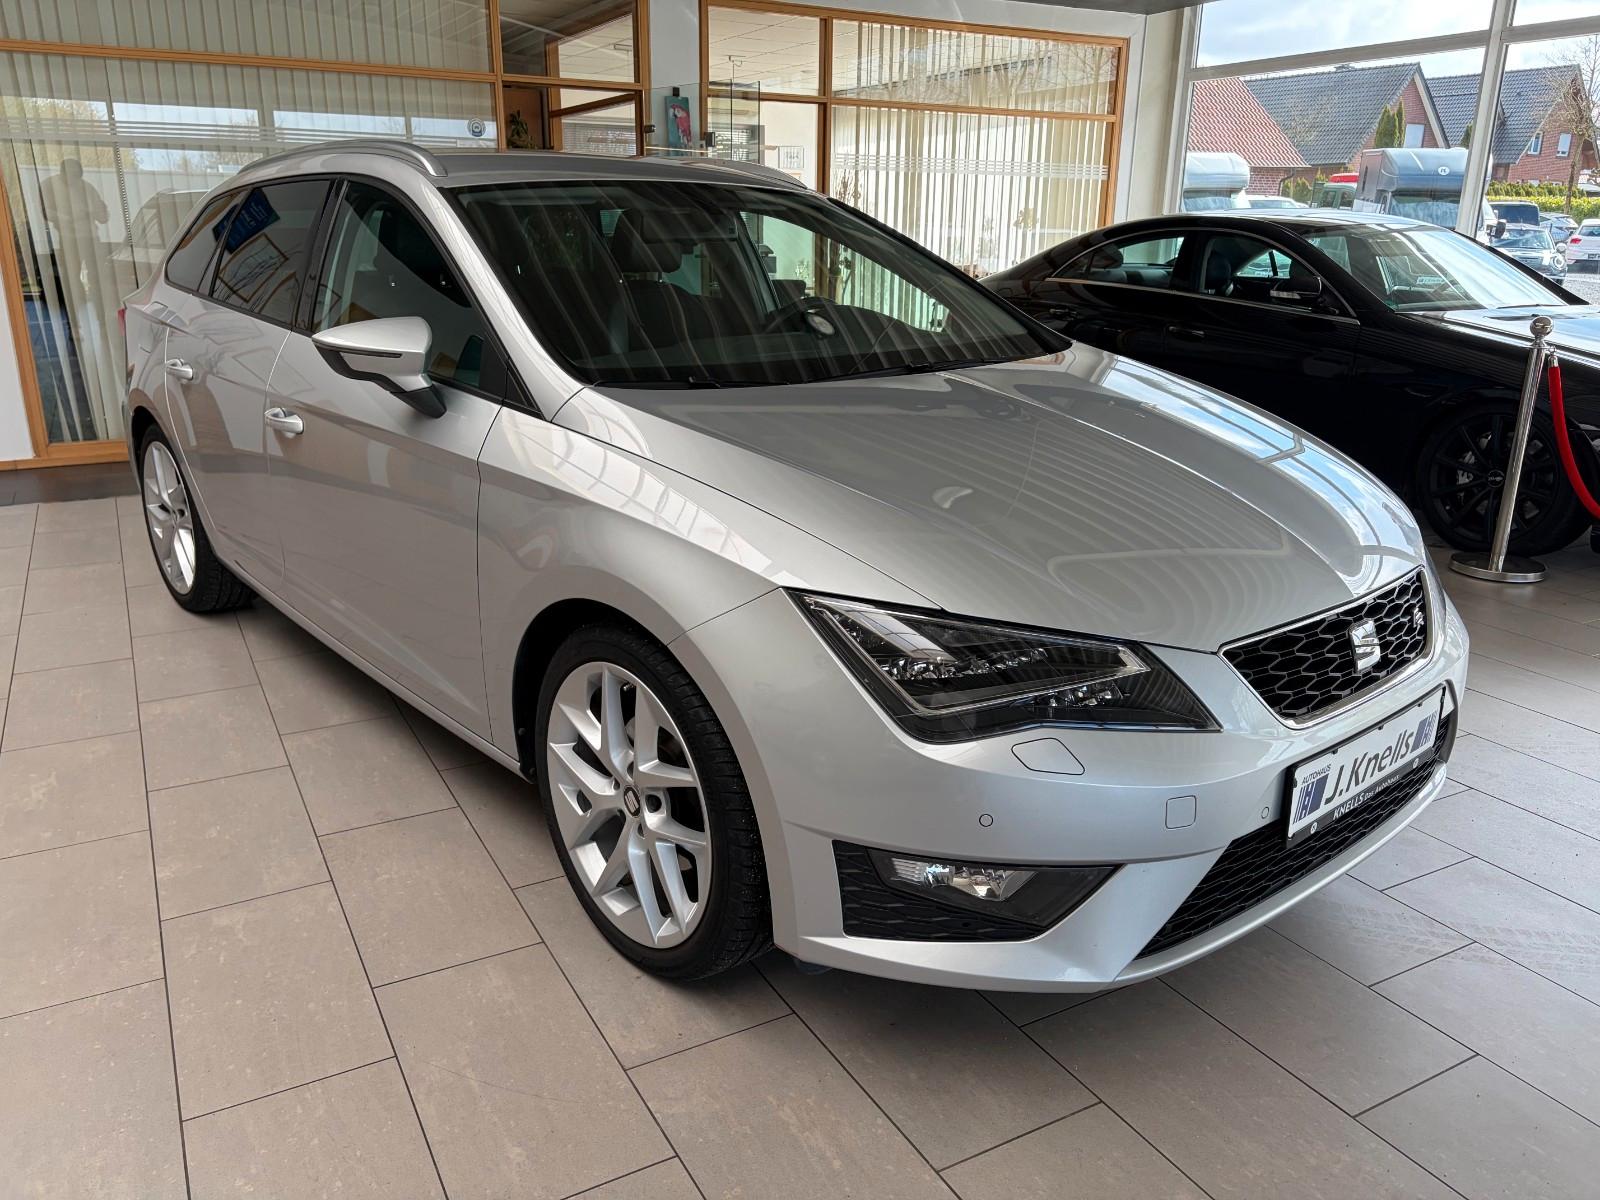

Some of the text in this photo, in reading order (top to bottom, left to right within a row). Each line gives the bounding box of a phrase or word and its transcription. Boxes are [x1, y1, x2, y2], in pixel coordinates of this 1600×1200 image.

[1301, 763, 1331, 785] AUTOHAUS
[1324, 729, 1415, 806] J.Knells
[1332, 792, 1365, 821] KNELLS
